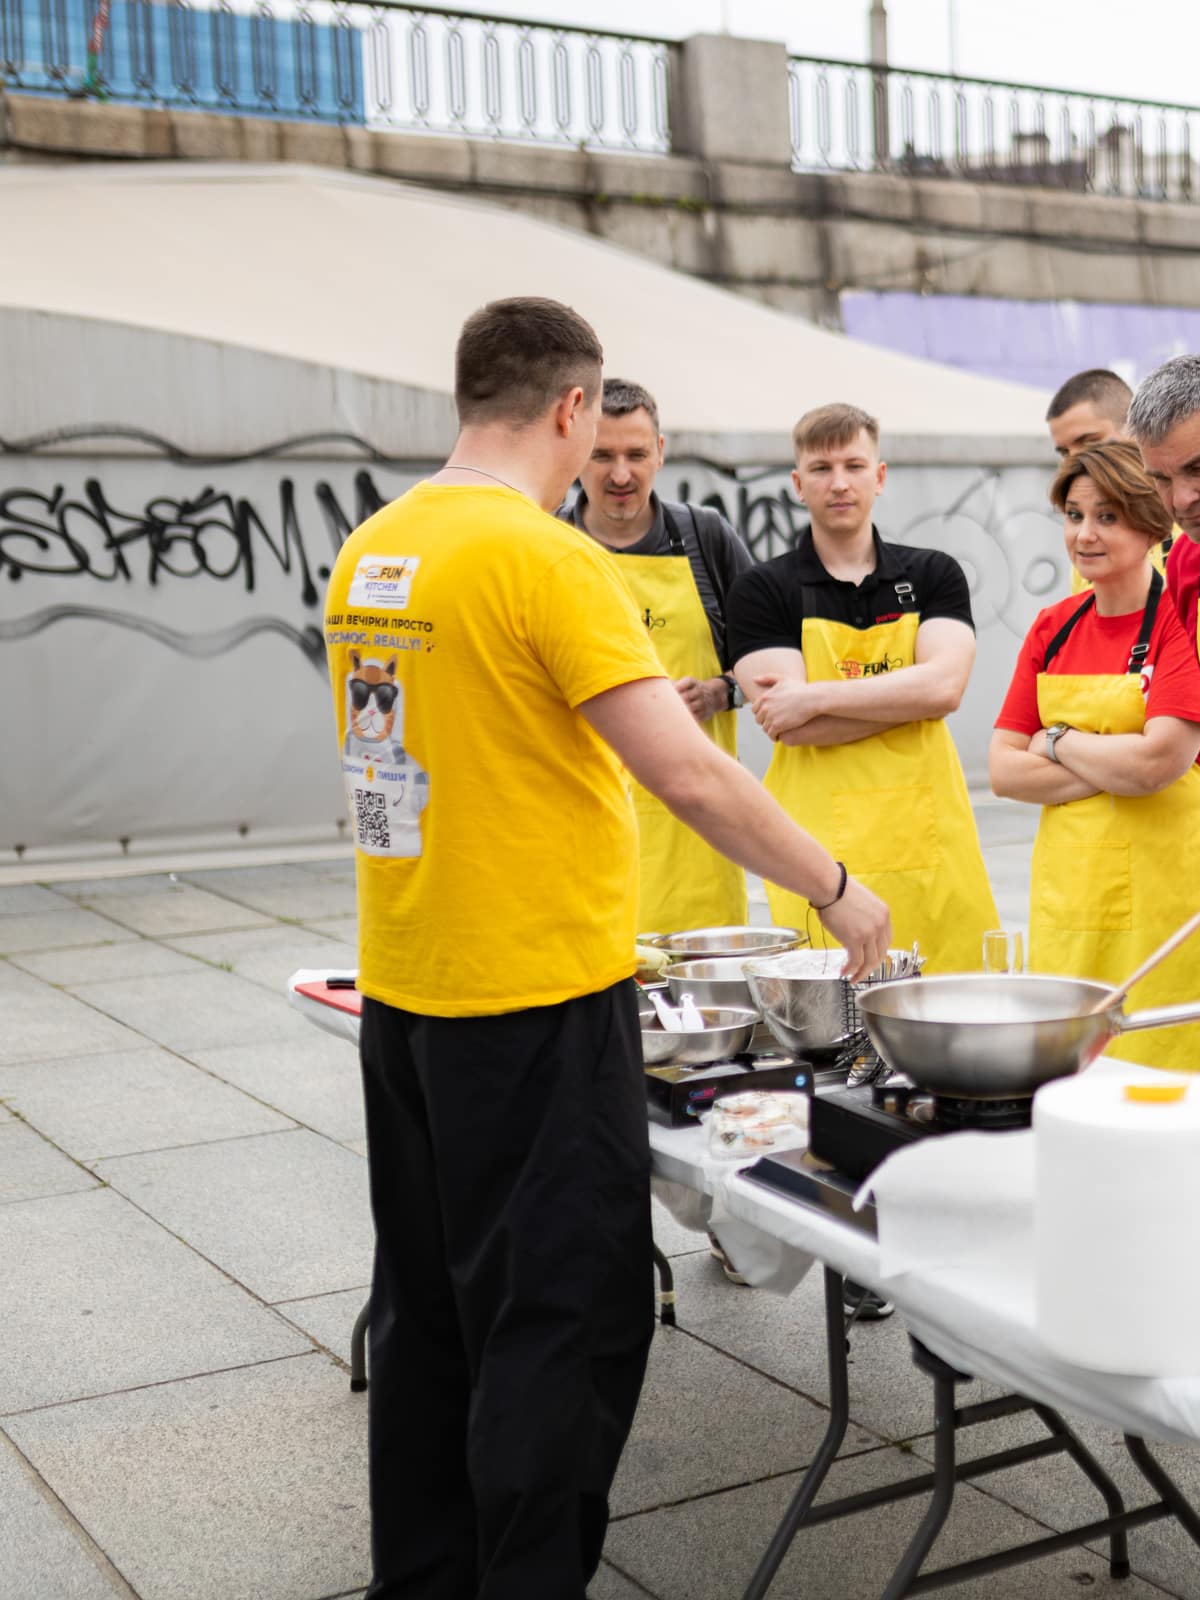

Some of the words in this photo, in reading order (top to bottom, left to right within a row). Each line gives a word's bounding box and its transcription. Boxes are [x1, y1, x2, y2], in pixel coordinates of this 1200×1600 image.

[379, 566, 404, 579] FUN
[365, 581, 399, 592] KITCHEN
[346, 614, 389, 629] ВЕЧІРКИ
[391, 618, 434, 633] ПРОСТО
[327, 631, 371, 648] ОСМОС,
[863, 660, 889, 677] FUN
